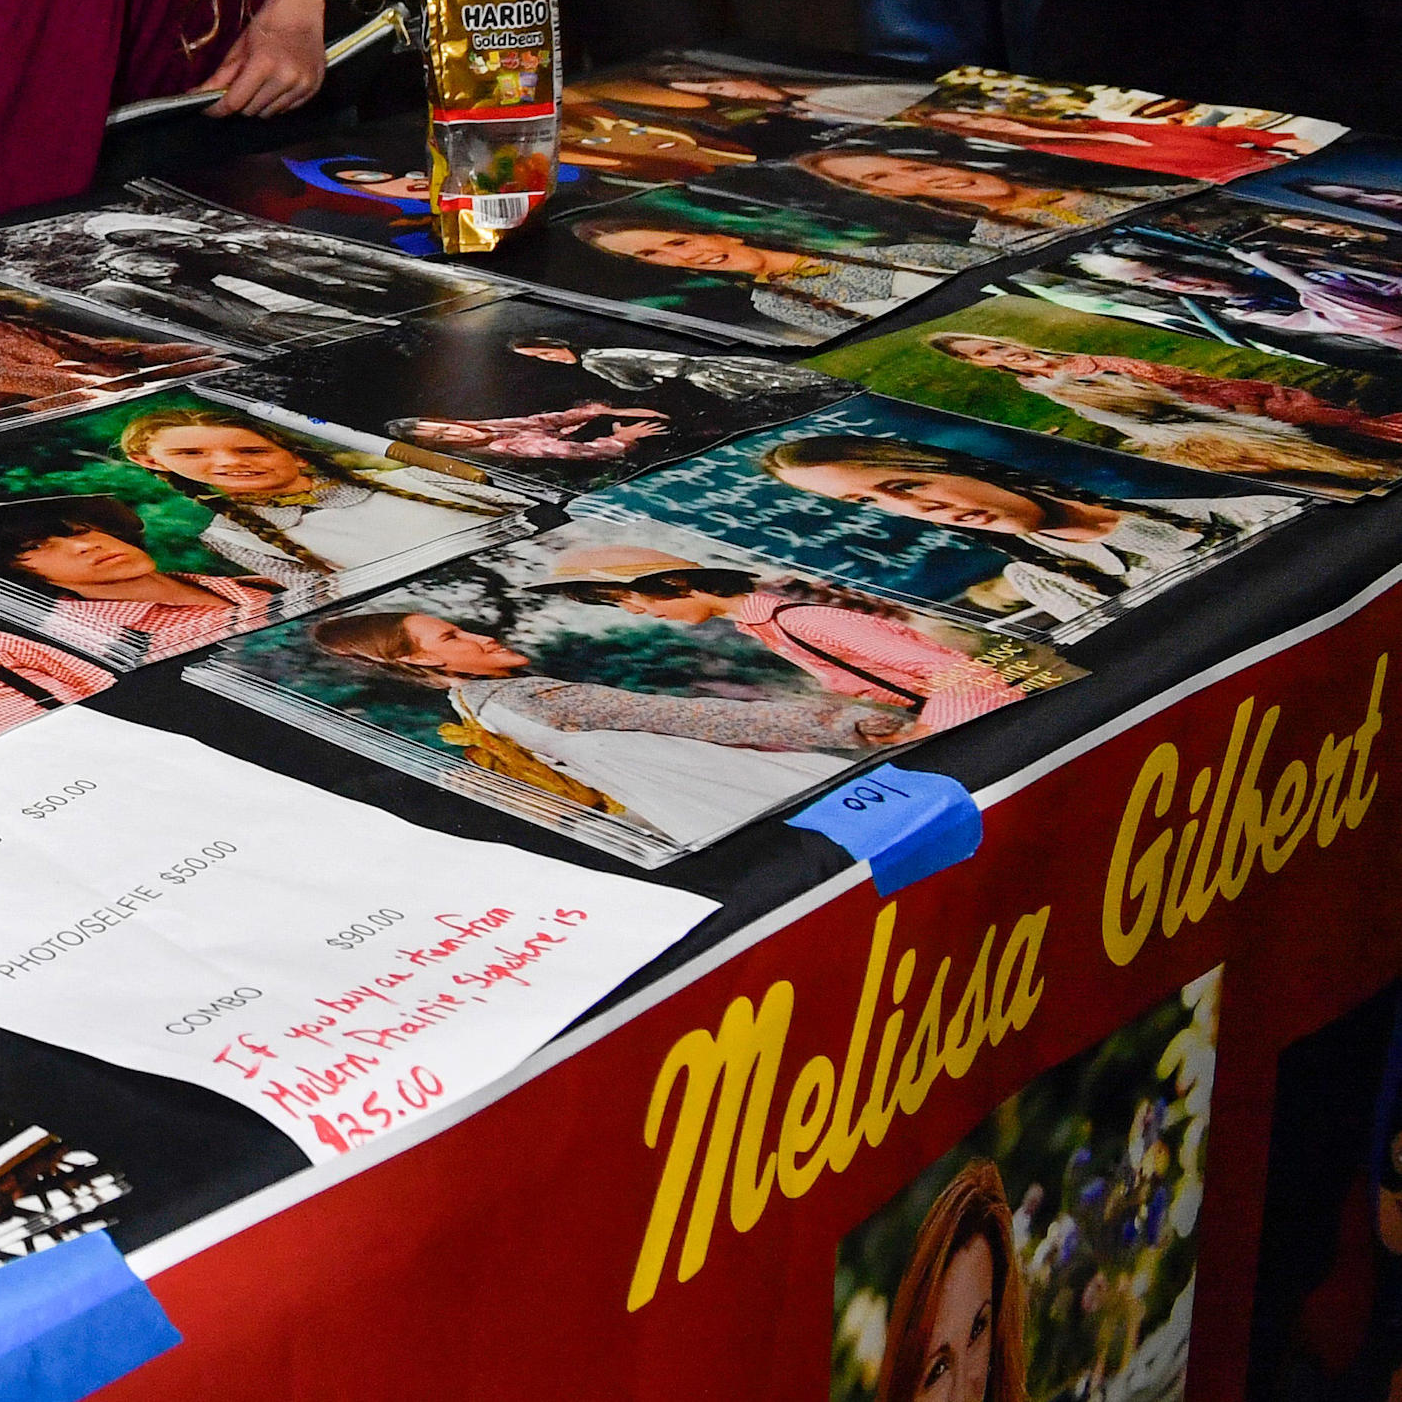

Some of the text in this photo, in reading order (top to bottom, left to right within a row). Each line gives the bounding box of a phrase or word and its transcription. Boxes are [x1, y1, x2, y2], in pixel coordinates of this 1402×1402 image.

[462, 0, 548, 30] HARIBO
[472, 32, 543, 50] Goldbears
[21, 779, 98, 820] $50.00
[159, 839, 238, 885] $50.00
[165, 908, 405, 1036] COMBO $90.00
[212, 907, 516, 1078] If you buy an item from
[261, 1052, 380, 1119] Modern
[539, 907, 588, 927] is
[626, 652, 1389, 1313] Melissa Gilbert
